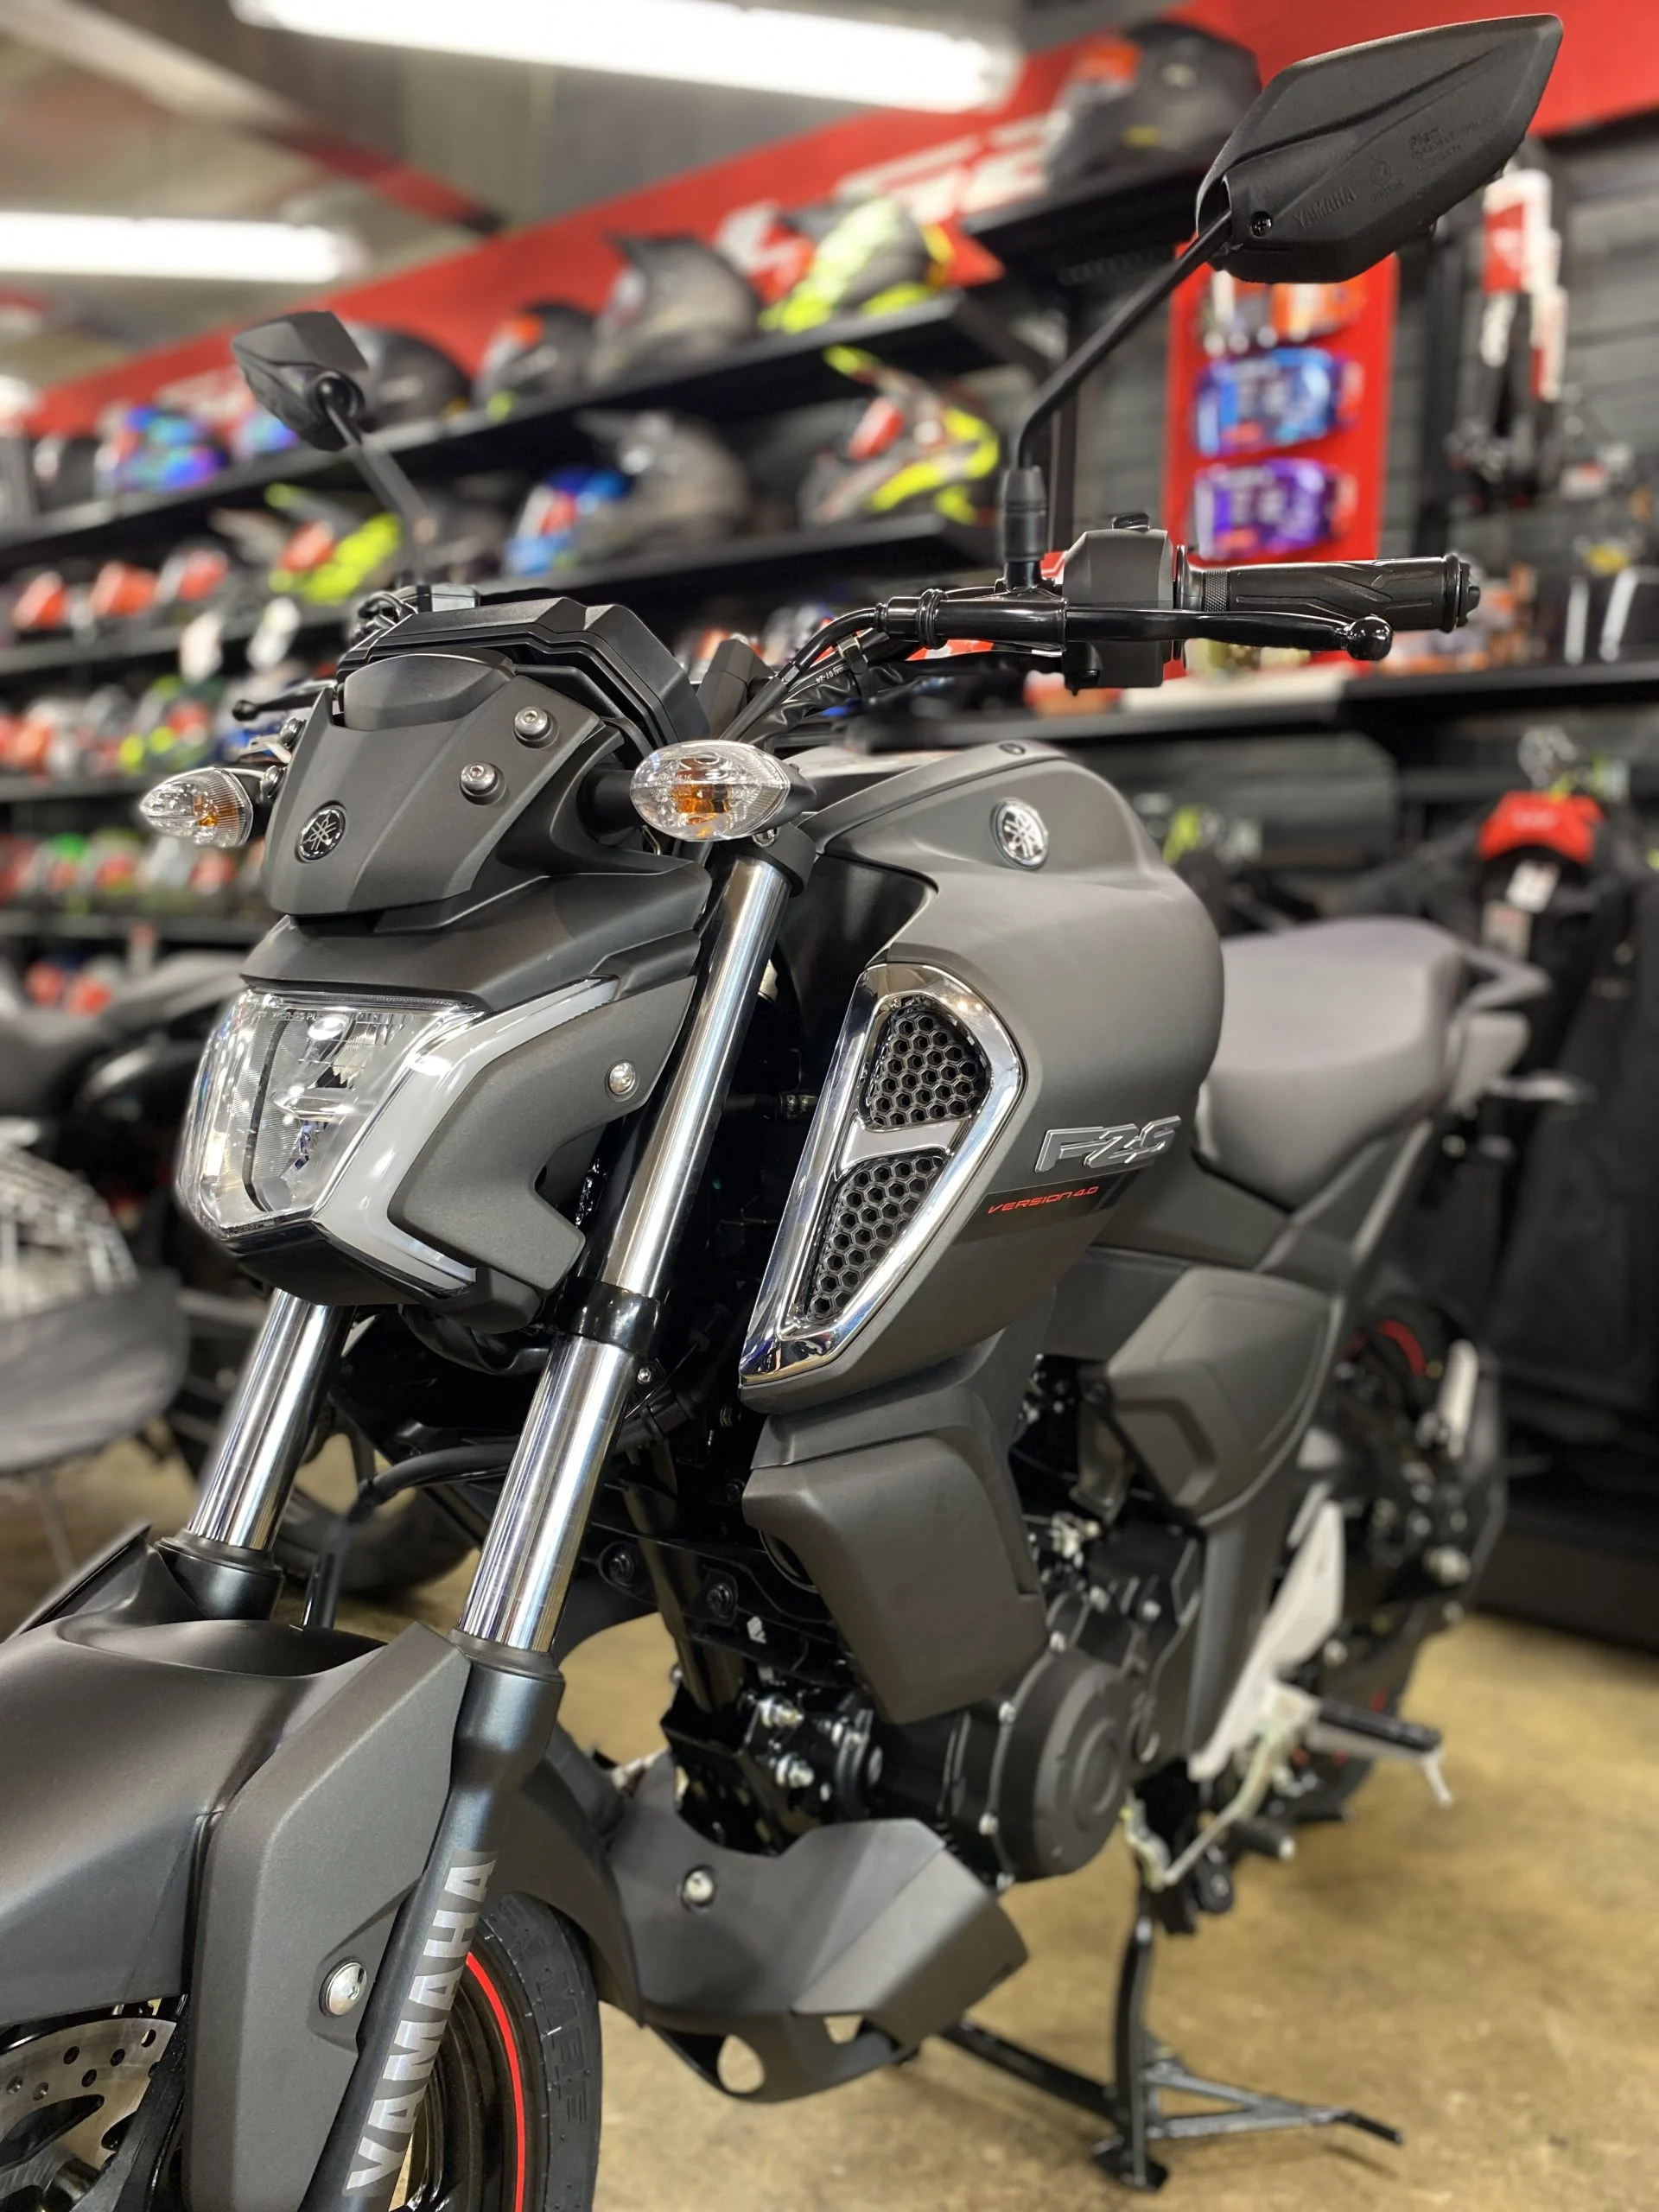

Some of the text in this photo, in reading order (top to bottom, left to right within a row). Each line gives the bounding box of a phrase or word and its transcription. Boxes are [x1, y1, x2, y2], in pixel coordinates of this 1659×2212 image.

[1294, 186, 1357, 228] YAMAHA
[988, 1185, 1099, 1213] VERSION 4.0
[346, 1860, 496, 2190] YAMAHA
